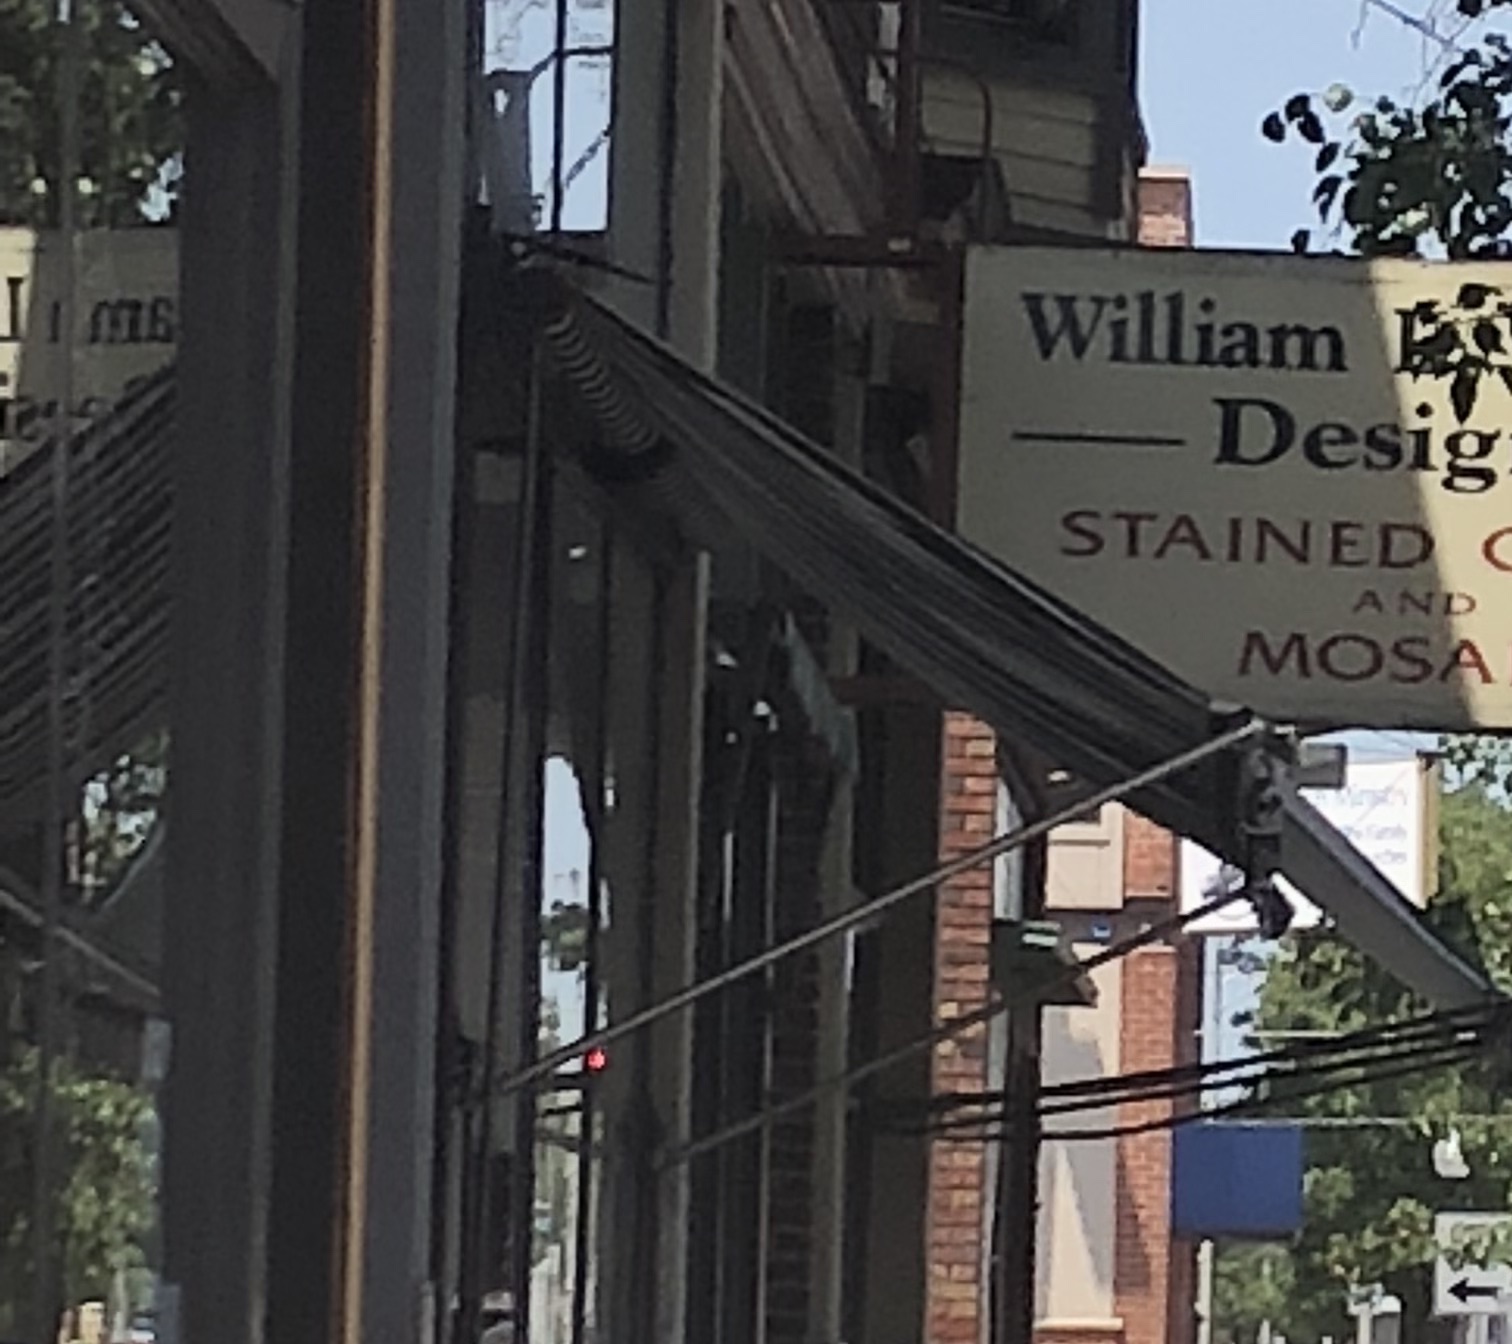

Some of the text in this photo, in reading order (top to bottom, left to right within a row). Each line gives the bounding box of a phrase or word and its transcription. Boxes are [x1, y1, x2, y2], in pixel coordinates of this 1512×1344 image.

[1022, 292, 1348, 374] William
[1061, 511, 1434, 570] STAINED
[1352, 590, 1477, 618] AND
